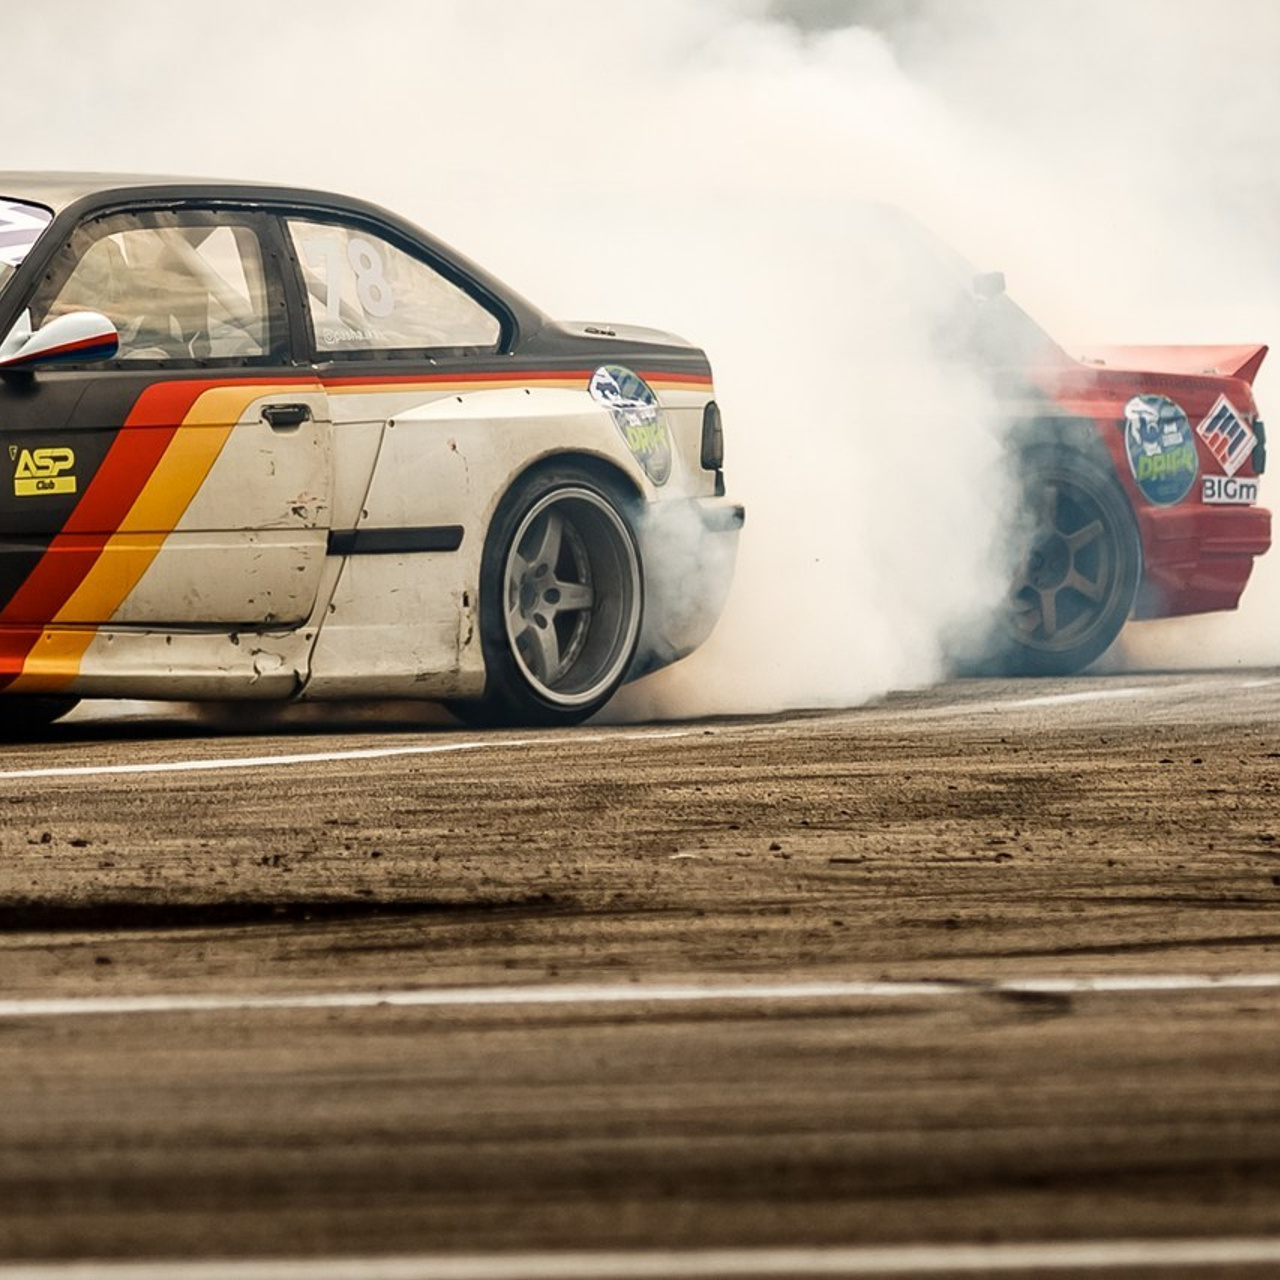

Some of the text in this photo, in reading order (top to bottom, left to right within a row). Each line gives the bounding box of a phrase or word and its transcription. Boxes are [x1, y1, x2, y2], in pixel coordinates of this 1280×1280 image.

[300, 237, 396, 321] 78
[15, 447, 75, 478] ASP
[36, 480, 56, 491] Club
[1203, 478, 1257, 499] BIGm
